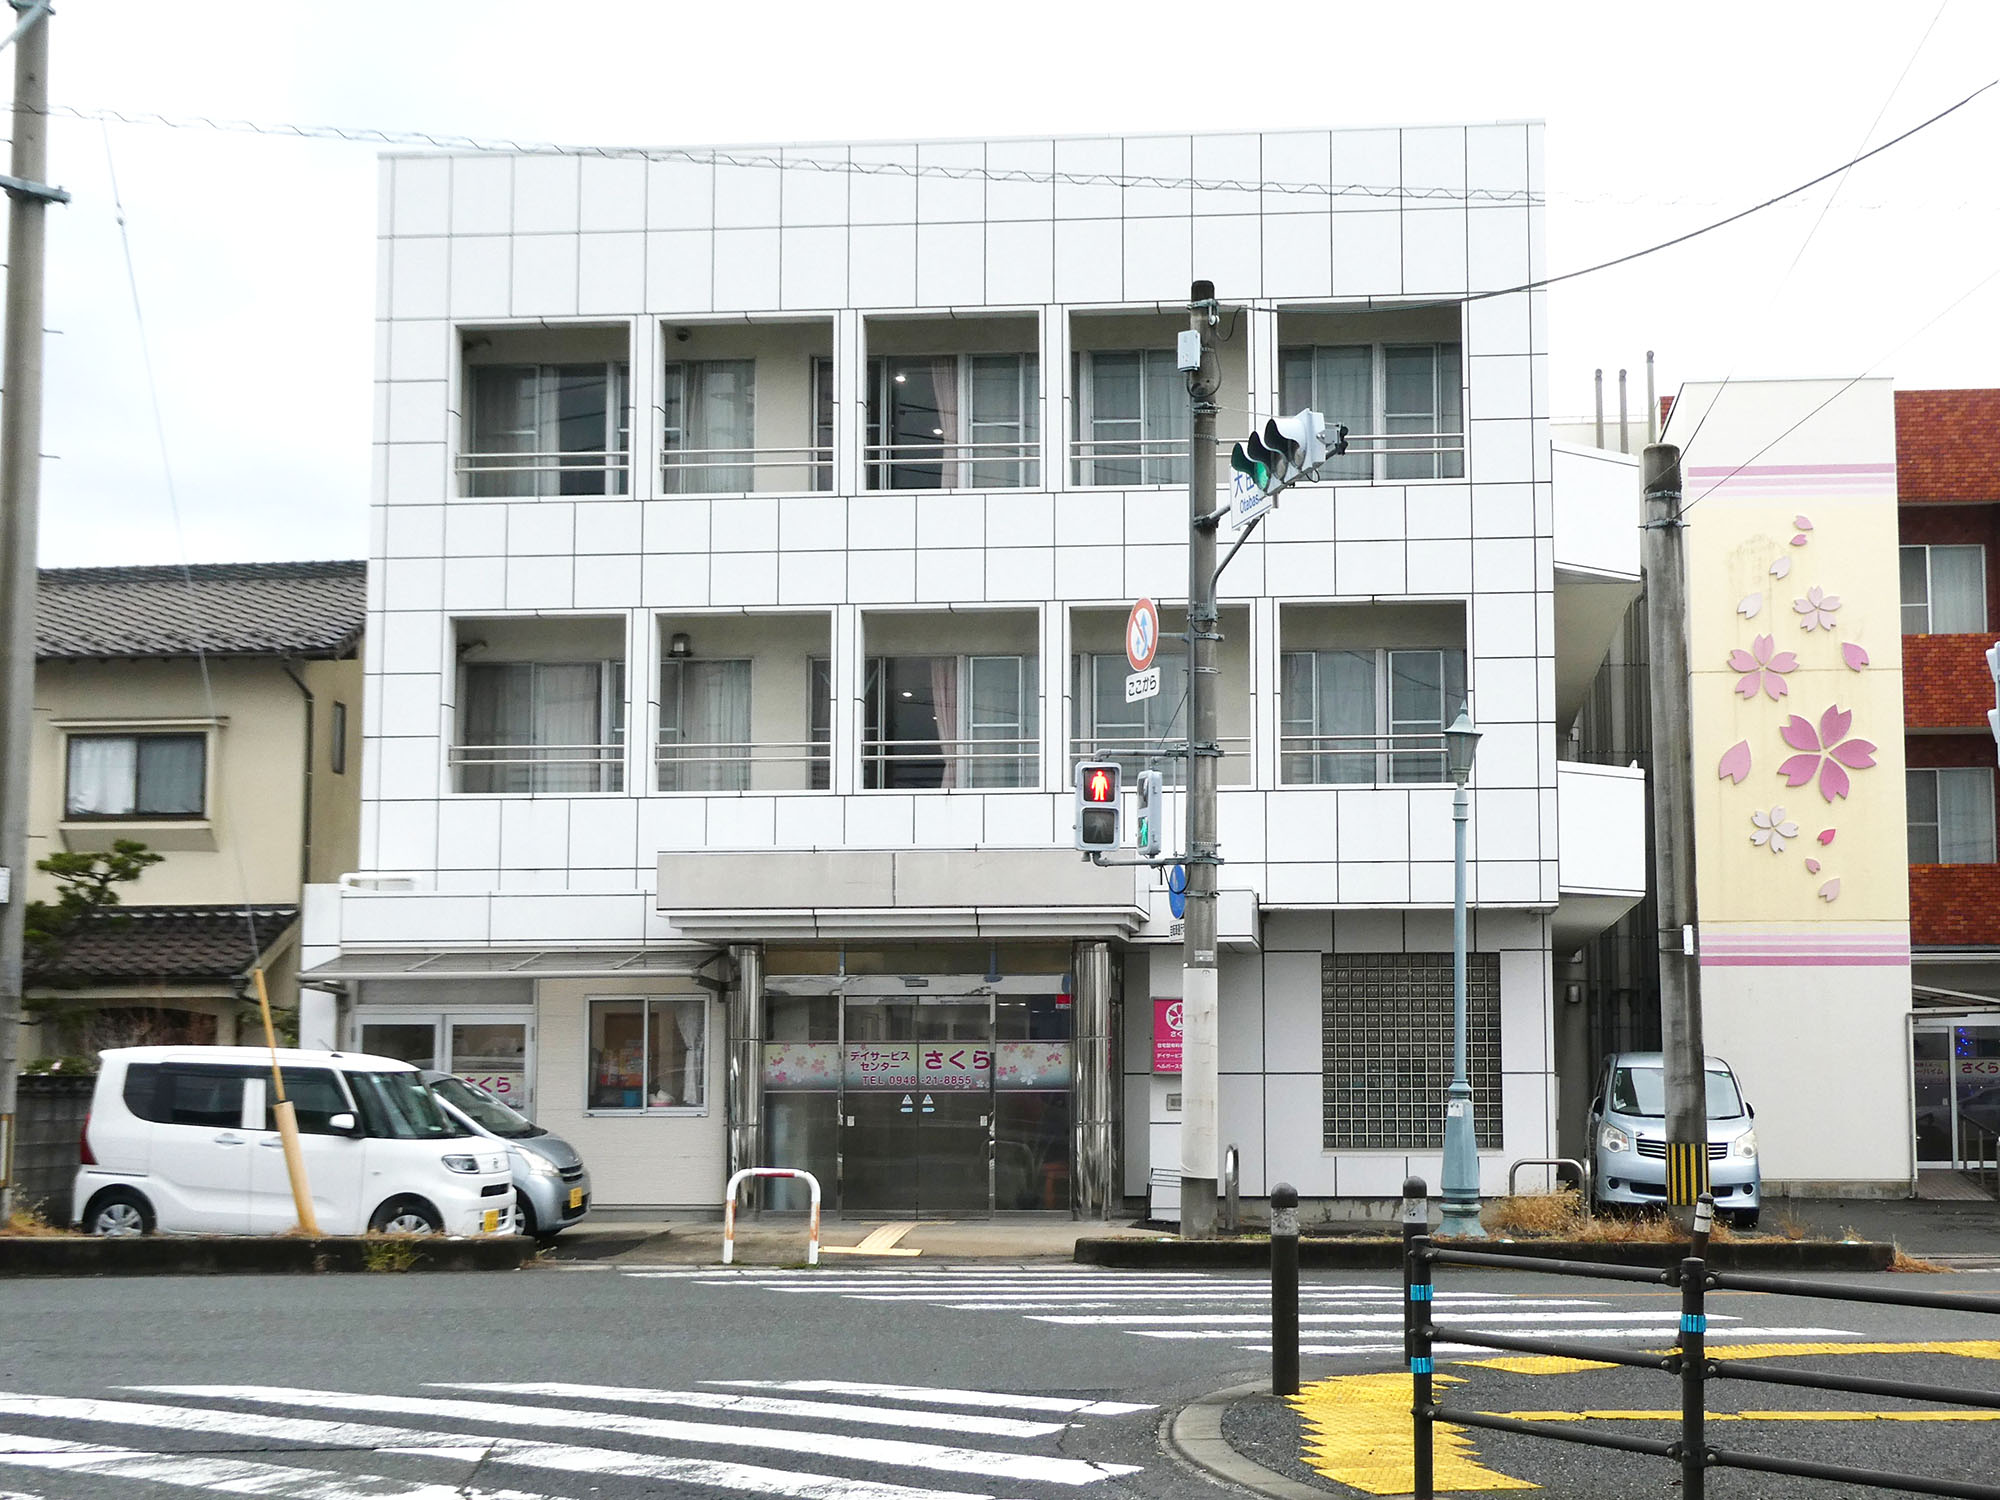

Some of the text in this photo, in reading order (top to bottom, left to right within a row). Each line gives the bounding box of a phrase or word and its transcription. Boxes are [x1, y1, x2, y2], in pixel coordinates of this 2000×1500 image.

[1240, 494, 1260, 514] Otabas
[1128, 675, 1157, 697] ここから
[850, 1051, 910, 1061] デイサービス
[925, 1050, 990, 1070] さくら
[860, 1062, 900, 1072] センター
[1961, 1062, 1999, 1074] さくら
[862, 1075, 972, 1085] TEL 0948-21-8855
